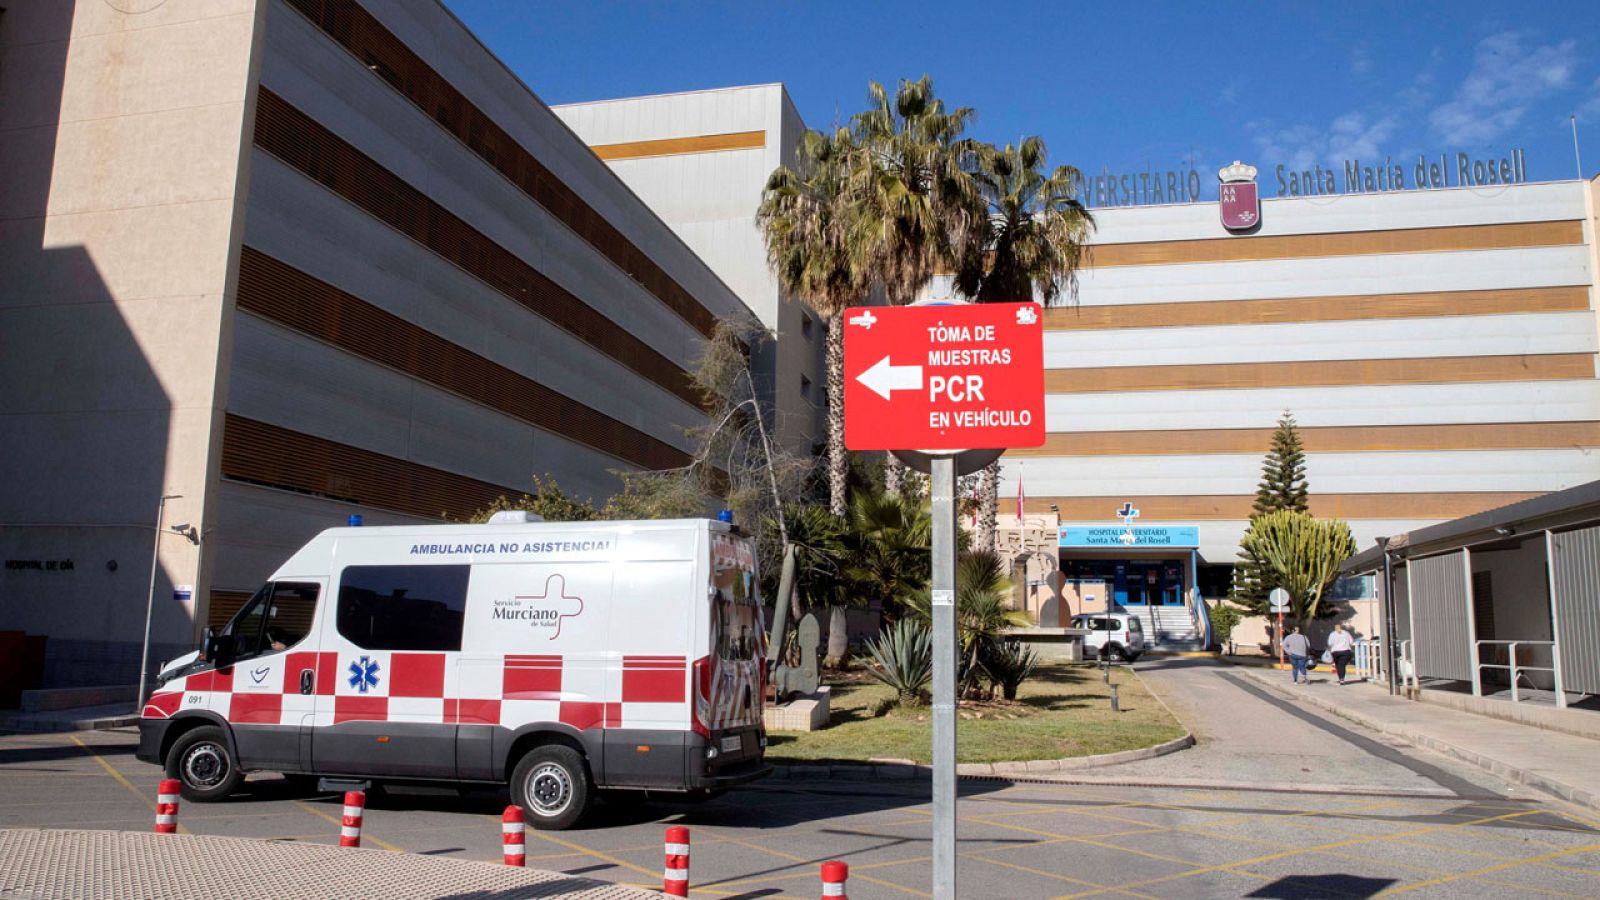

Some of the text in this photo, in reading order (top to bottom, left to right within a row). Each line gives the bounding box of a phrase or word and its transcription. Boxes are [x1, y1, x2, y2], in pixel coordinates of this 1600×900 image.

[1276, 164, 1335, 196] Santa
[1344, 156, 1404, 192] María
[1415, 154, 1446, 188] del
[1458, 149, 1526, 186] Rosell
[975, 325, 995, 341] DE
[928, 348, 1011, 365] MUESTRAS
[929, 375, 984, 402] PCR
[930, 407, 1031, 427] EN VEHÍCULO
[1088, 528, 1118, 536] HOSPITAL
[1086, 535, 1108, 544] Santa
[1135, 535, 1146, 544] del
[1149, 535, 1170, 544] Rosell
[410, 543, 495, 554] AMBULANCIA
[499, 543, 519, 553] NO
[5, 559, 42, 570] HOSPITAL
[46, 560, 58, 570] DE
[493, 606, 558, 620] Murciano
[189, 695, 202, 704] 091
